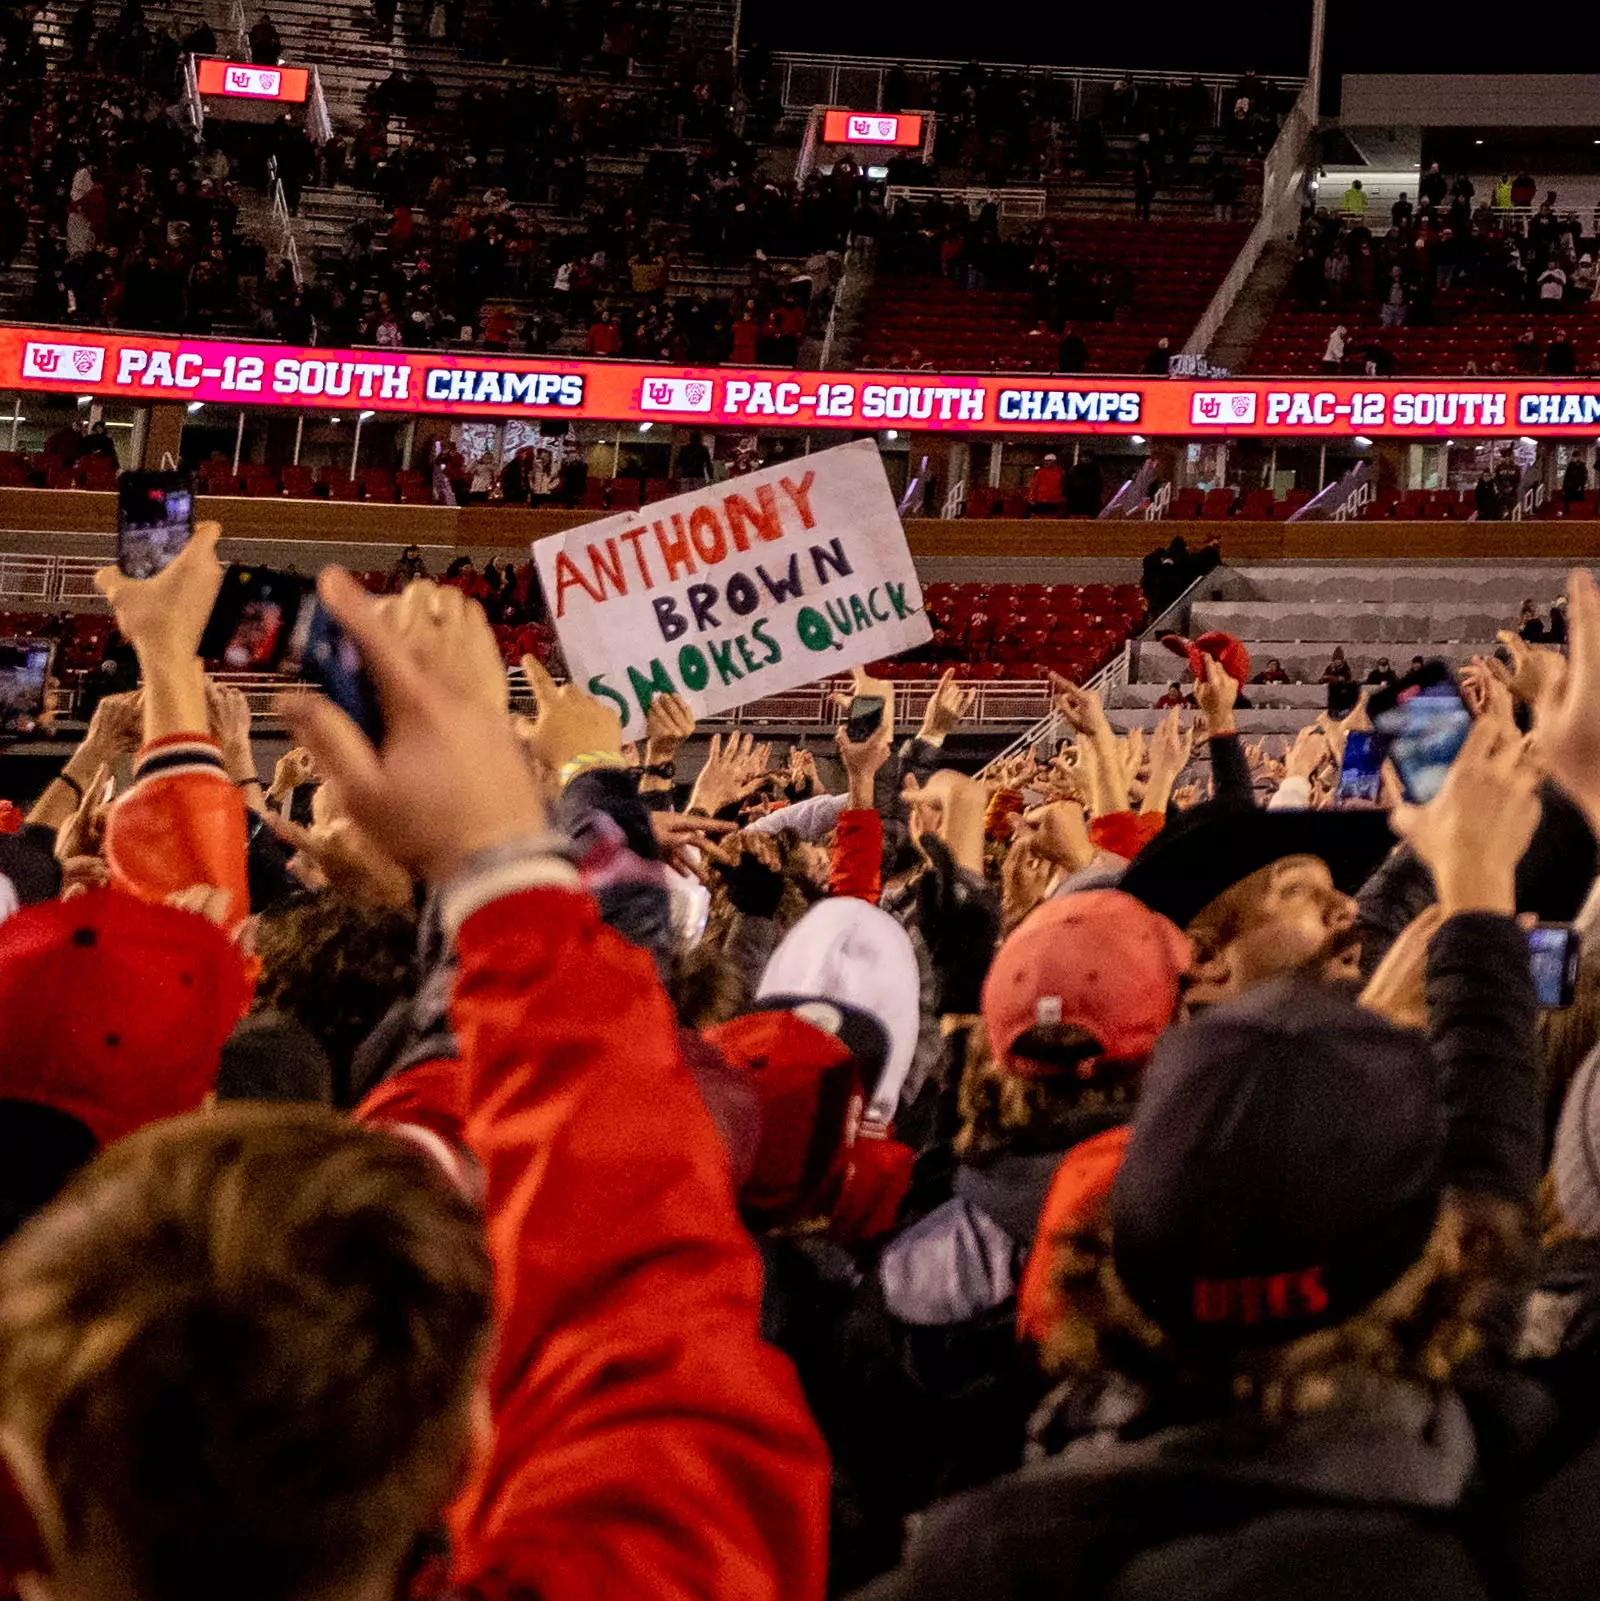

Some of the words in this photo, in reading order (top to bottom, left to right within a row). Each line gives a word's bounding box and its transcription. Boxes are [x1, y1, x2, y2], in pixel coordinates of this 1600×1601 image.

[117, 349, 264, 391] PAC-12
[273, 360, 410, 399] SOUTH
[426, 370, 583, 406] CHAMPS
[723, 382, 854, 417] PAC-12
[862, 386, 985, 420] SOUTH
[999, 391, 1140, 421] CHAMPS
[1266, 393, 1385, 424] PAC-12
[1393, 393, 1506, 424] SOUTH
[554, 469, 816, 619] ANTHONY
[651, 536, 855, 644] BROWN
[587, 616, 782, 729] SMOKES
[796, 581, 917, 652] QUACK
